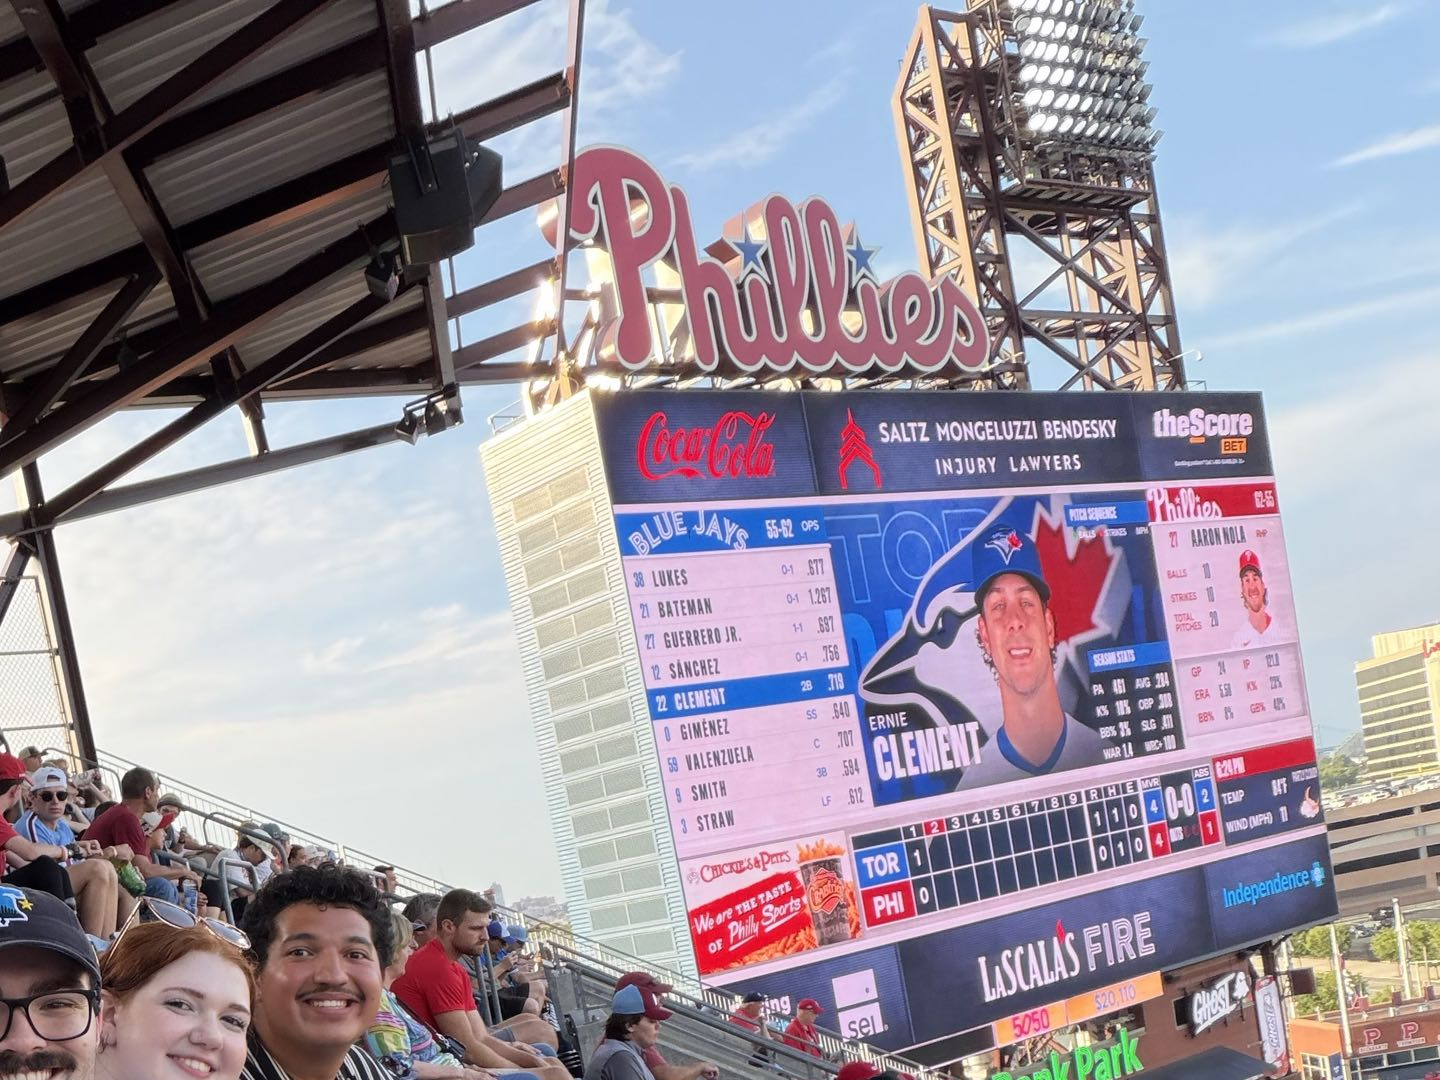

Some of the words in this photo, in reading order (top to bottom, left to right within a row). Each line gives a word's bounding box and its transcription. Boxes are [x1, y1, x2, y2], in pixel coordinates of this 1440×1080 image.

[570, 144, 989, 372] Phillies
[879, 421, 930, 443] SALTZ
[935, 420, 1038, 442] MONGELUZZI
[1043, 419, 1117, 439] BENDESKY
[1153, 408, 1253, 437] theScore
[1223, 440, 1244, 452] BET
[935, 456, 996, 475] INJURY
[1009, 453, 1081, 473] LAWYERS
[1147, 487, 1223, 522] Phillies
[628, 510, 688, 557] BLUE
[692, 509, 749, 550] JAYS
[765, 518, 795, 539] 55-62
[801, 519, 820, 532] OPS
[1169, 531, 1178, 548] 27
[1190, 526, 1222, 548] AARON
[1222, 525, 1247, 546] NOLA
[633, 571, 644, 588] 38
[652, 569, 688, 587] LUKES
[781, 564, 794, 576] 0-1
[806, 558, 824, 577] .677
[1167, 569, 1188, 579] BALLS
[640, 602, 650, 619] 21
[657, 598, 713, 618] BATEMAN
[786, 593, 799, 604] 0-1
[808, 587, 831, 606] 1.267
[1171, 592, 1197, 603] STRIKES
[1174, 613, 1195, 622] TOTAL
[1175, 621, 1202, 632] PITCHES
[645, 633, 655, 650] 27
[663, 627, 721, 649] GUERRERO
[725, 626, 742, 642] JR.
[651, 665, 660, 681] 12
[795, 651, 808, 662] 0-1
[822, 644, 840, 662] .756
[1192, 666, 1202, 677] GP
[656, 695, 668, 712] 22
[674, 688, 726, 711] CLEMENT
[801, 680, 813, 691] 2B
[828, 672, 844, 692] .719
[1092, 683, 1105, 696] PA
[1135, 677, 1151, 689] AVG
[1195, 689, 1210, 700] ERA
[664, 726, 671, 742] 0
[680, 717, 730, 741] GIMÉNEZ
[806, 709, 817, 720] SS
[832, 701, 850, 720] .640
[868, 711, 908, 732] ERNIE
[1142, 719, 1157, 732] SLG
[667, 757, 679, 774] 59
[685, 745, 754, 771] VALENZUELA
[813, 739, 820, 749] C
[837, 730, 854, 749] .707
[873, 721, 982, 780] CLEMENT
[1103, 747, 1121, 759] WAR
[691, 780, 727, 801] SMITH
[816, 767, 827, 778] 3B
[842, 758, 860, 777] .594
[1194, 767, 1210, 779] ABS
[681, 819, 687, 834] 3
[696, 810, 735, 832] STRAW
[822, 796, 832, 807] LF
[848, 787, 864, 806] .612
[910, 826, 917, 838] 1
[930, 822, 939, 833] 2
[951, 818, 960, 829] 3
[972, 813, 981, 824] 4
[992, 809, 1001, 820] 5
[1012, 804, 1020, 816] 6
[1031, 800, 1039, 812] 7
[1051, 797, 1059, 808] 8
[1068, 793, 1077, 804] 9
[1090, 789, 1099, 800] R
[1107, 786, 1116, 796] H
[1126, 782, 1134, 793] E
[1141, 778, 1159, 789] MVR
[1221, 790, 1245, 805] TEMP
[862, 852, 900, 879] TOR
[914, 849, 922, 866] 1
[1094, 811, 1101, 826] 1
[1112, 807, 1119, 823] 1
[1129, 803, 1137, 820] 0
[1150, 800, 1158, 814] 4
[1164, 782, 1195, 821] 0-0
[1202, 788, 1210, 803] 2
[1225, 817, 1248, 833] WIND
[1249, 811, 1273, 829] (MPH)
[1280, 806, 1288, 822] 11
[873, 891, 904, 919] PHI
[919, 887, 929, 904] 0
[1099, 845, 1108, 861] 0
[1117, 841, 1125, 857] 1
[1134, 837, 1143, 853] 0
[1155, 832, 1164, 847] 4
[1206, 820, 1214, 835] 1
[1223, 869, 1310, 908] Independence
[694, 911, 714, 935] We
[716, 907, 733, 925] are
[734, 896, 758, 916] THE
[757, 881, 792, 904] TASTE
[708, 938, 723, 954] OF
[727, 914, 759, 945] Philly
[761, 898, 800, 926] Sports
[1083, 911, 1156, 973] FIRE
[1094, 983, 1137, 1012] $20,110
[1192, 973, 1236, 1024] GHOST
